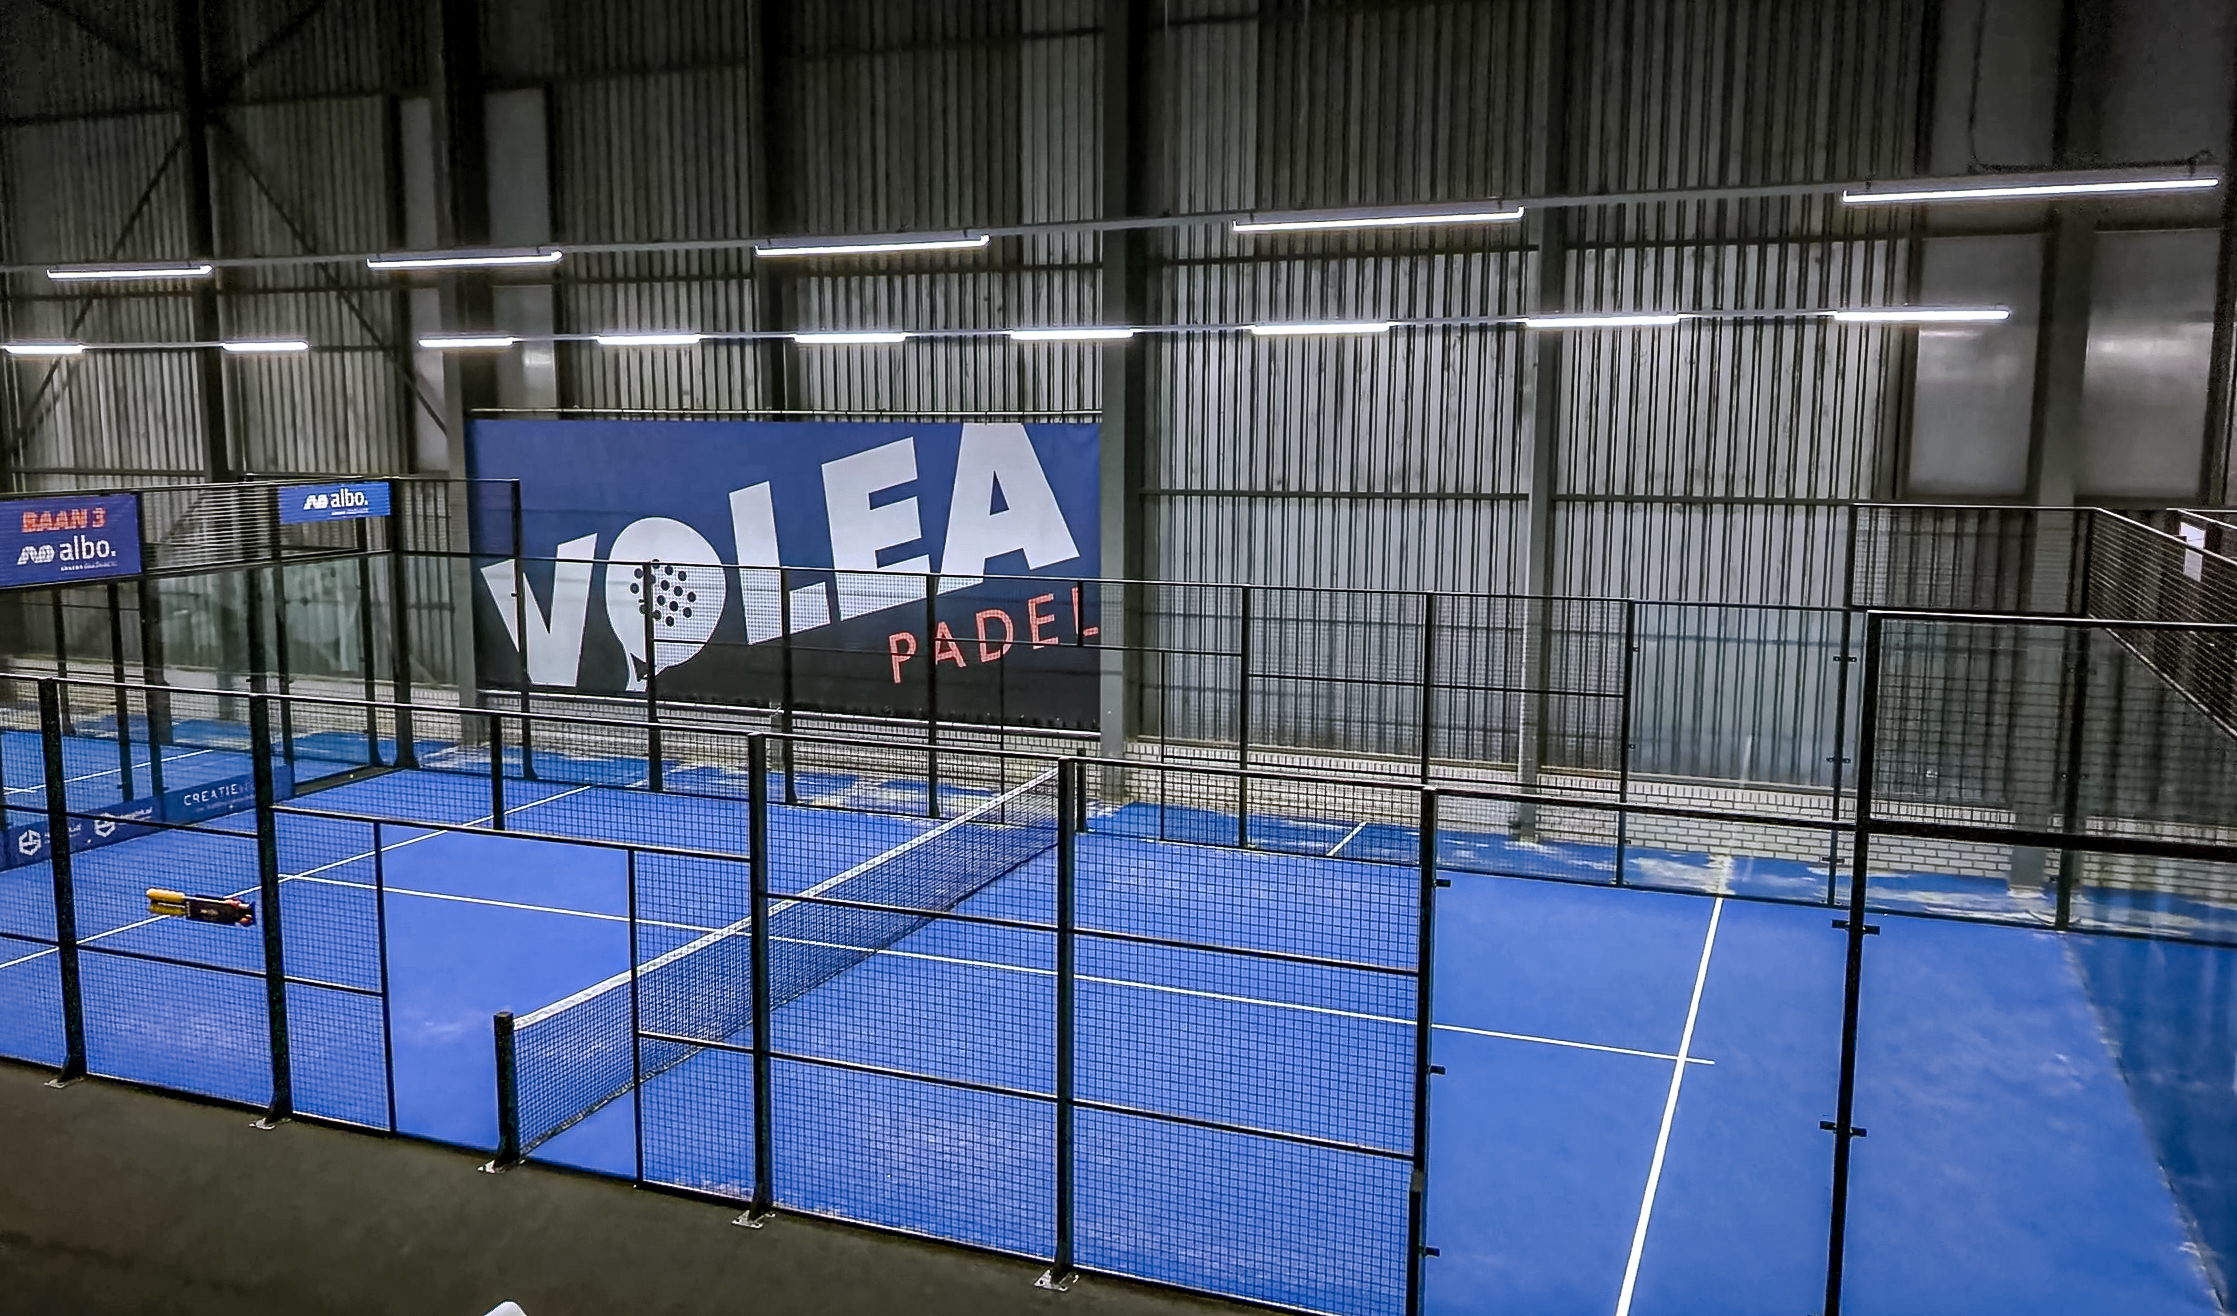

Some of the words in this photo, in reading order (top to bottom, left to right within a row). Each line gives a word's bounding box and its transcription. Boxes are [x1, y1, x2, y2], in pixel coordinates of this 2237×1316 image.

[22, 508, 88, 533] BAAN
[92, 507, 106, 528] 3
[481, 422, 1080, 692] VOLEA
[888, 586, 1099, 684] PADEL
